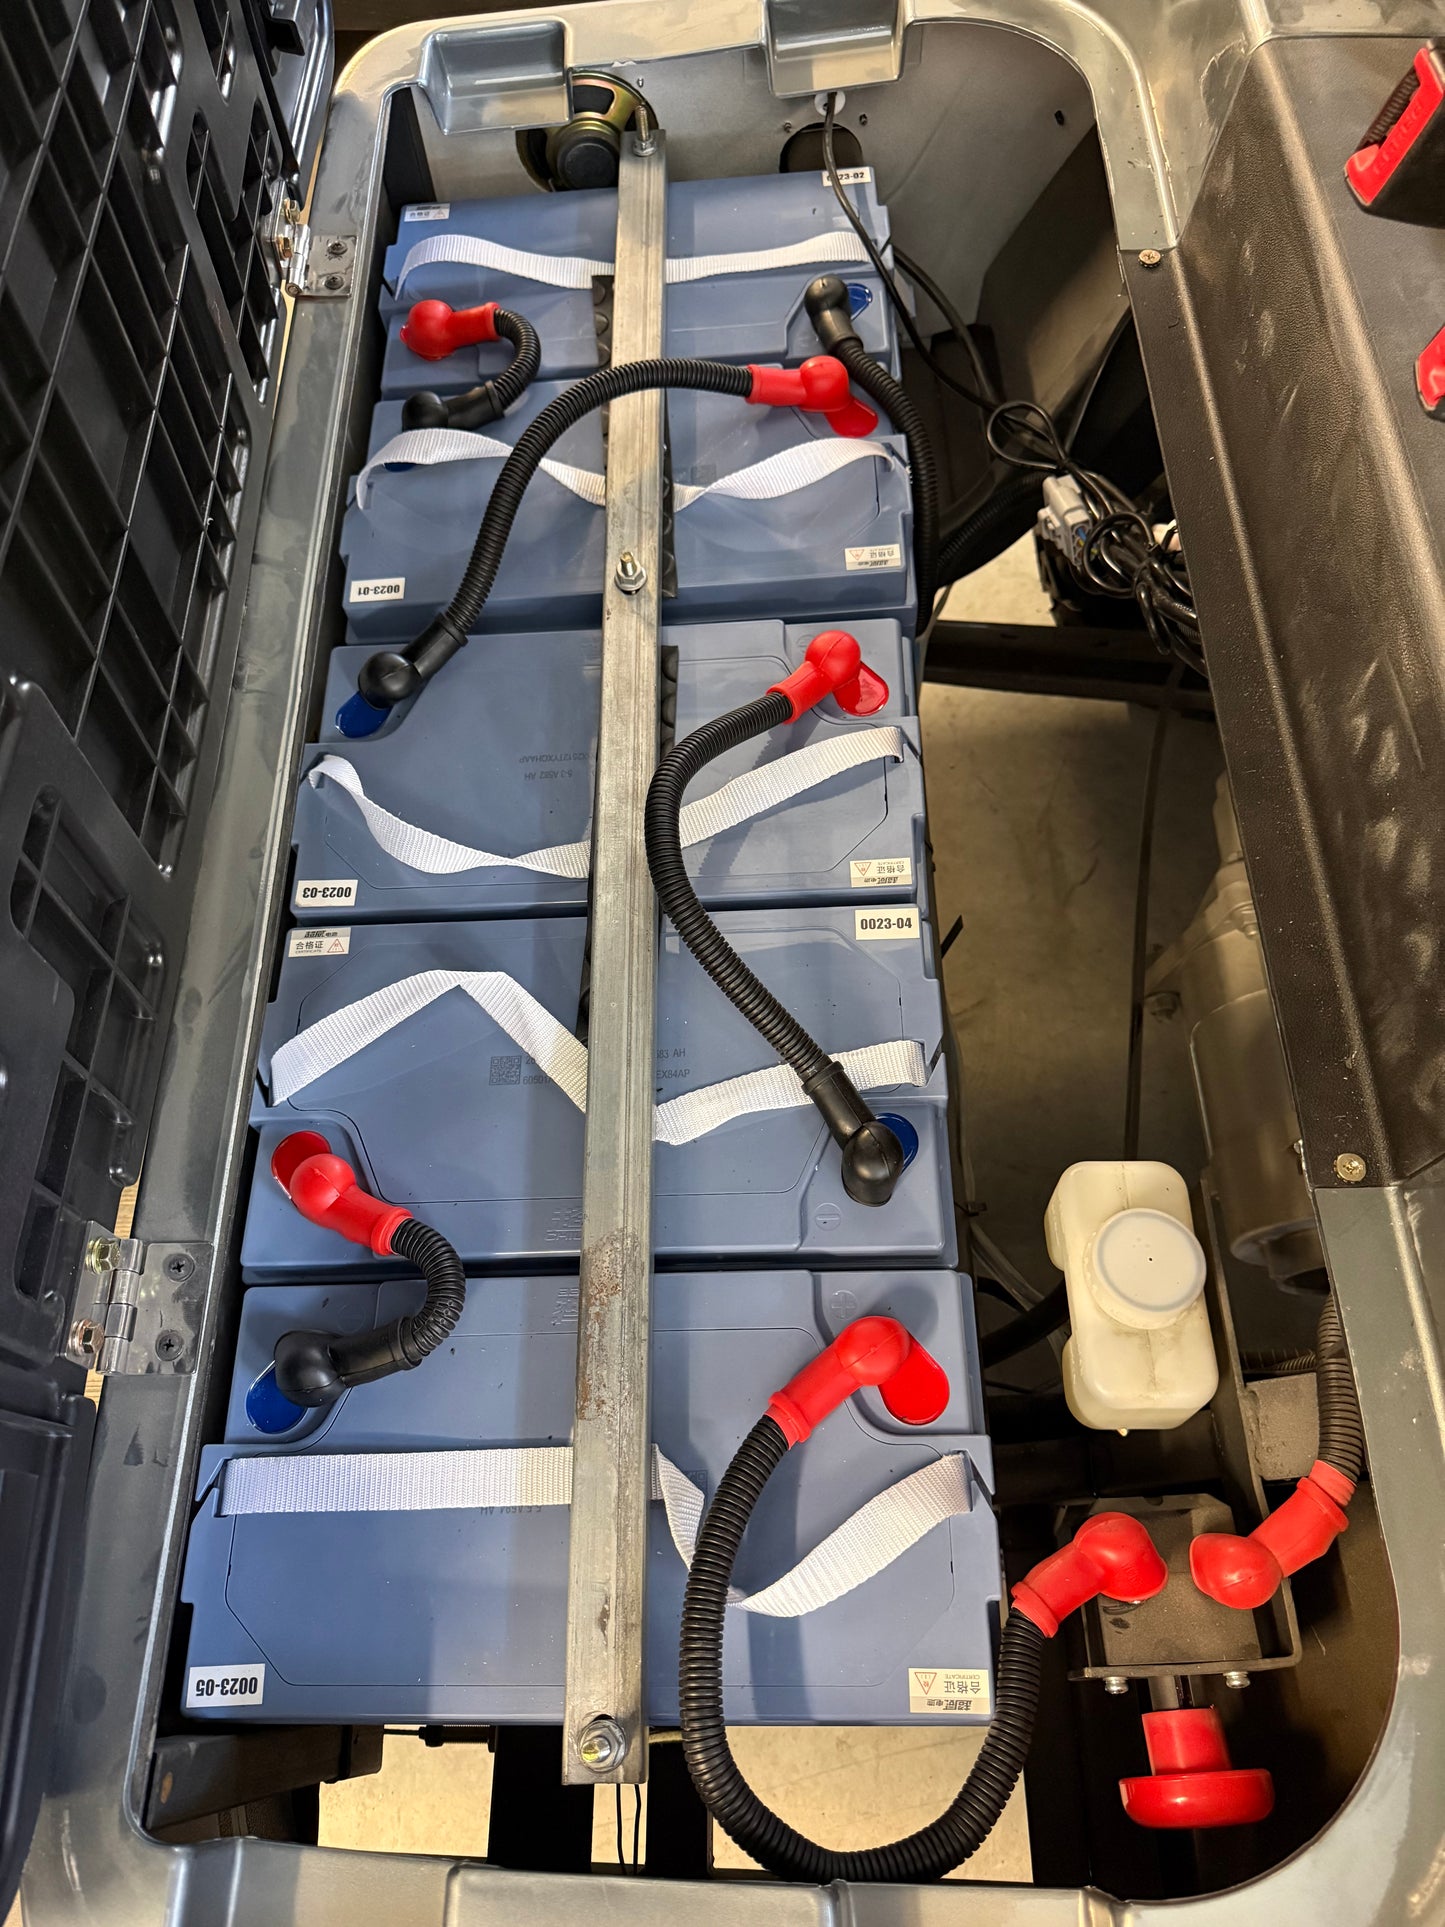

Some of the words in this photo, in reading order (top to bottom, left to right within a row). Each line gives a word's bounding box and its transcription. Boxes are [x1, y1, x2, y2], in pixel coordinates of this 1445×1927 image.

[358, 584, 400, 596] 0023-01
[302, 886, 352, 898] 0023-03
[860, 917, 912, 930] 0023-04
[673, 1048, 686, 1057] AH
[196, 1677, 258, 1696] 0023-05
[944, 1680, 981, 1694] 合格证
